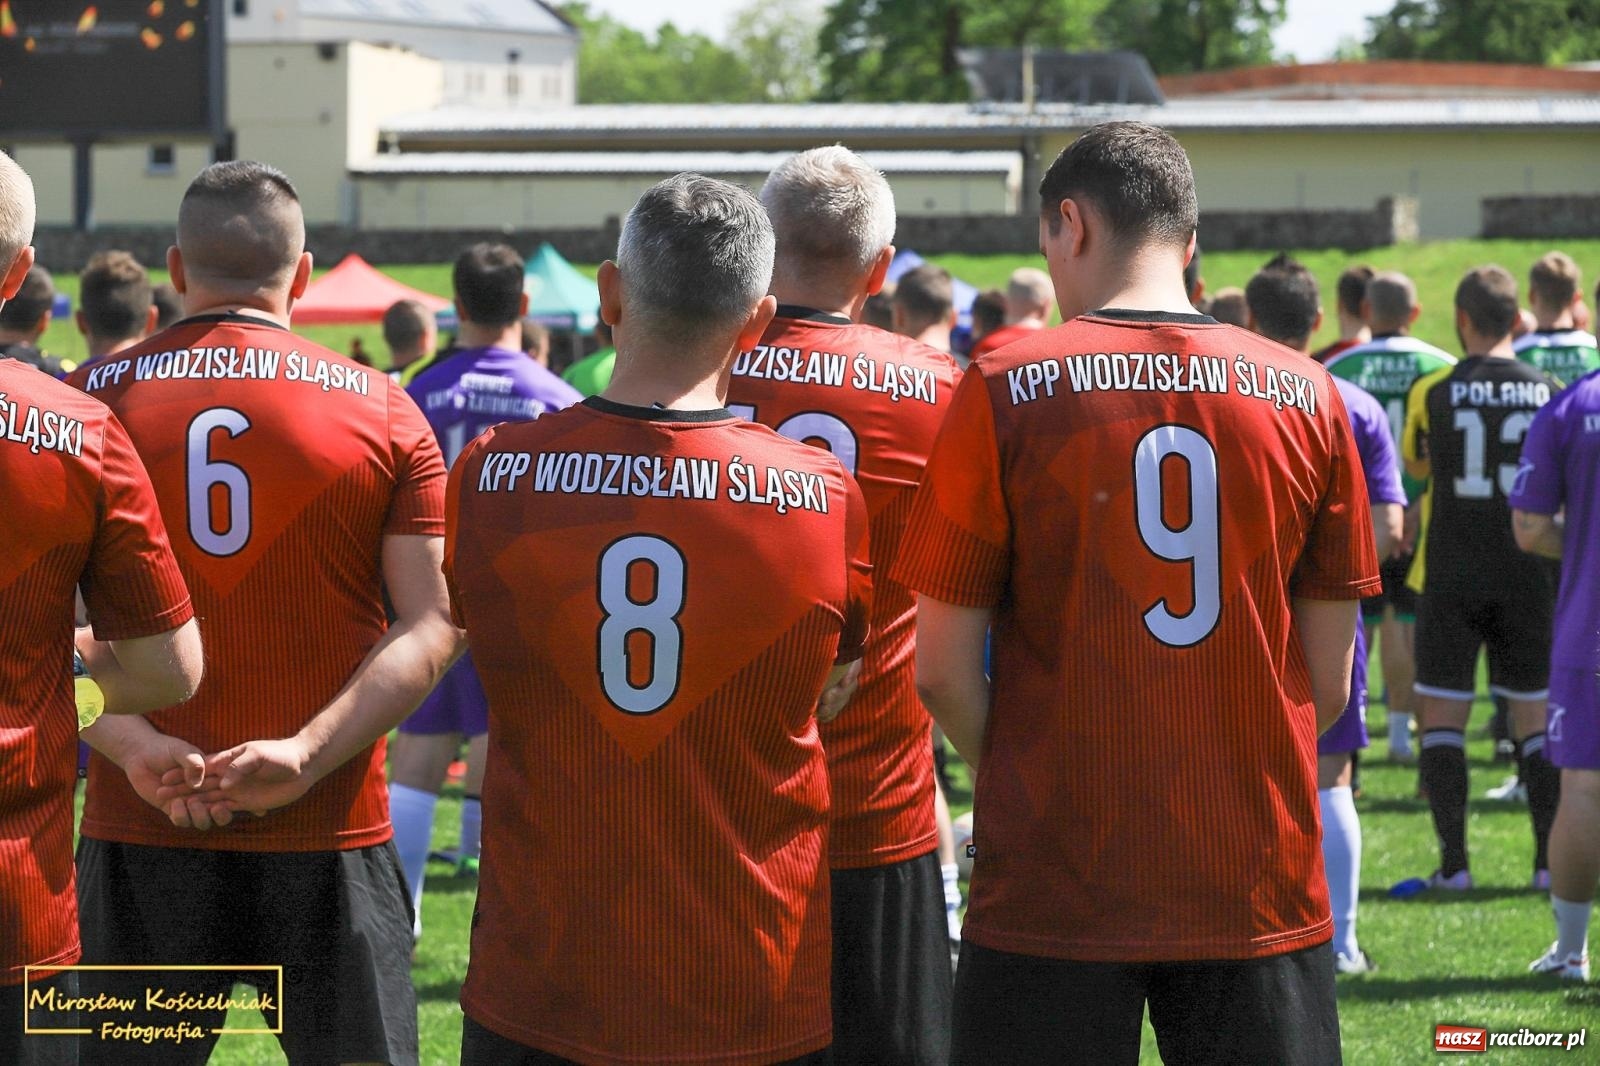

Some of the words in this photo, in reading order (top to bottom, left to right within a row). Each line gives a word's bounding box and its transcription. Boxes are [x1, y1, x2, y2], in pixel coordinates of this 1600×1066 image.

[85, 359, 130, 392] KPP
[134, 348, 280, 381] WODZISŁAW
[285, 350, 369, 396] ŚLĄSKI
[732, 344, 847, 387] DZISŁAW
[852, 352, 937, 405] ŚLĄSKI
[1007, 359, 1061, 405] KPP
[1065, 353, 1228, 393] WODZISŁAW
[1234, 354, 1317, 416] ŚLĄSKI
[186, 405, 252, 557] 6
[477, 452, 530, 492] KPP
[533, 451, 719, 500] WODZISŁAW
[727, 455, 829, 515] ŚLĄSKI
[1132, 422, 1222, 648] 9
[596, 532, 688, 716] 8
